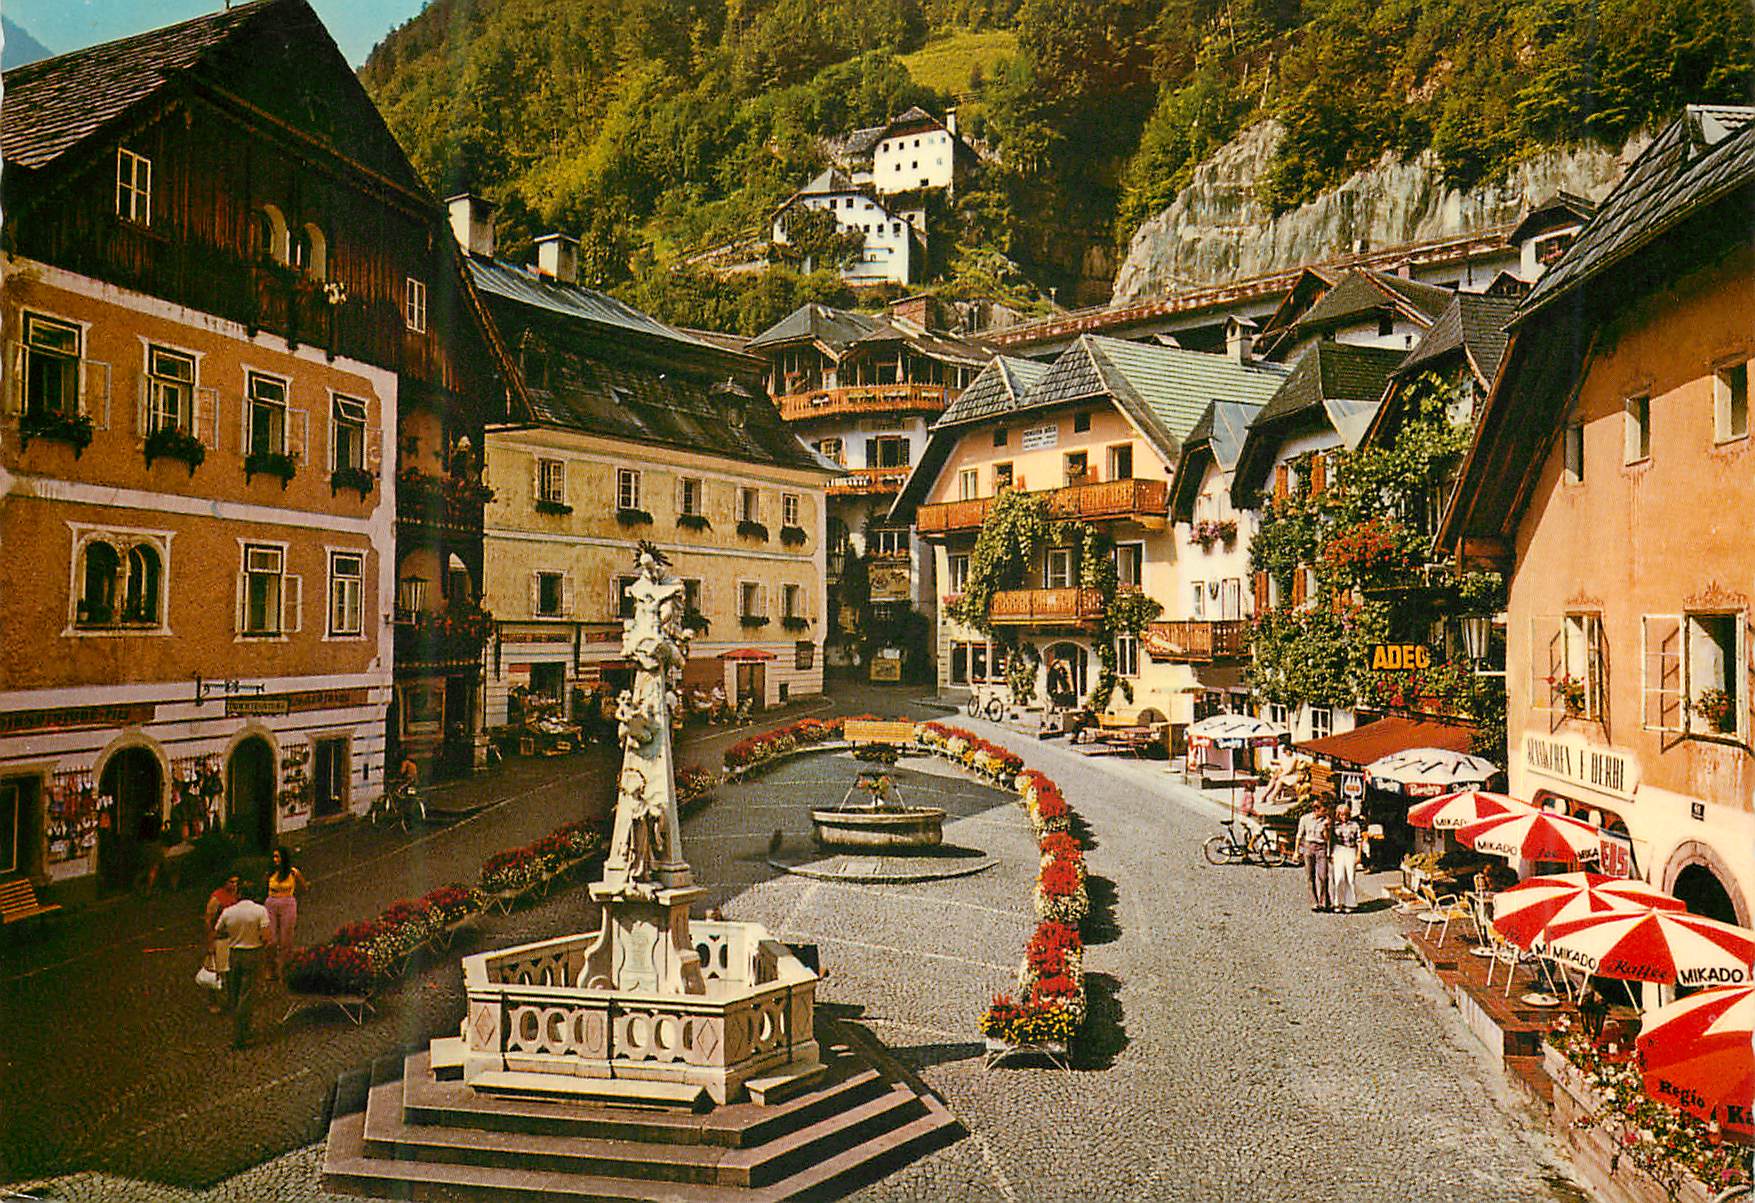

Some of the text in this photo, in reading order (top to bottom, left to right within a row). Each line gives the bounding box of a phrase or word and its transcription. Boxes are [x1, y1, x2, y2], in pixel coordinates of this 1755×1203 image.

[1373, 645, 1429, 669] ADEG
[1477, 839, 1518, 856] MIKADO
[1600, 840, 1628, 876] EIS
[1552, 945, 1594, 969] MIKADO
[1680, 967, 1744, 983] MIKADO
